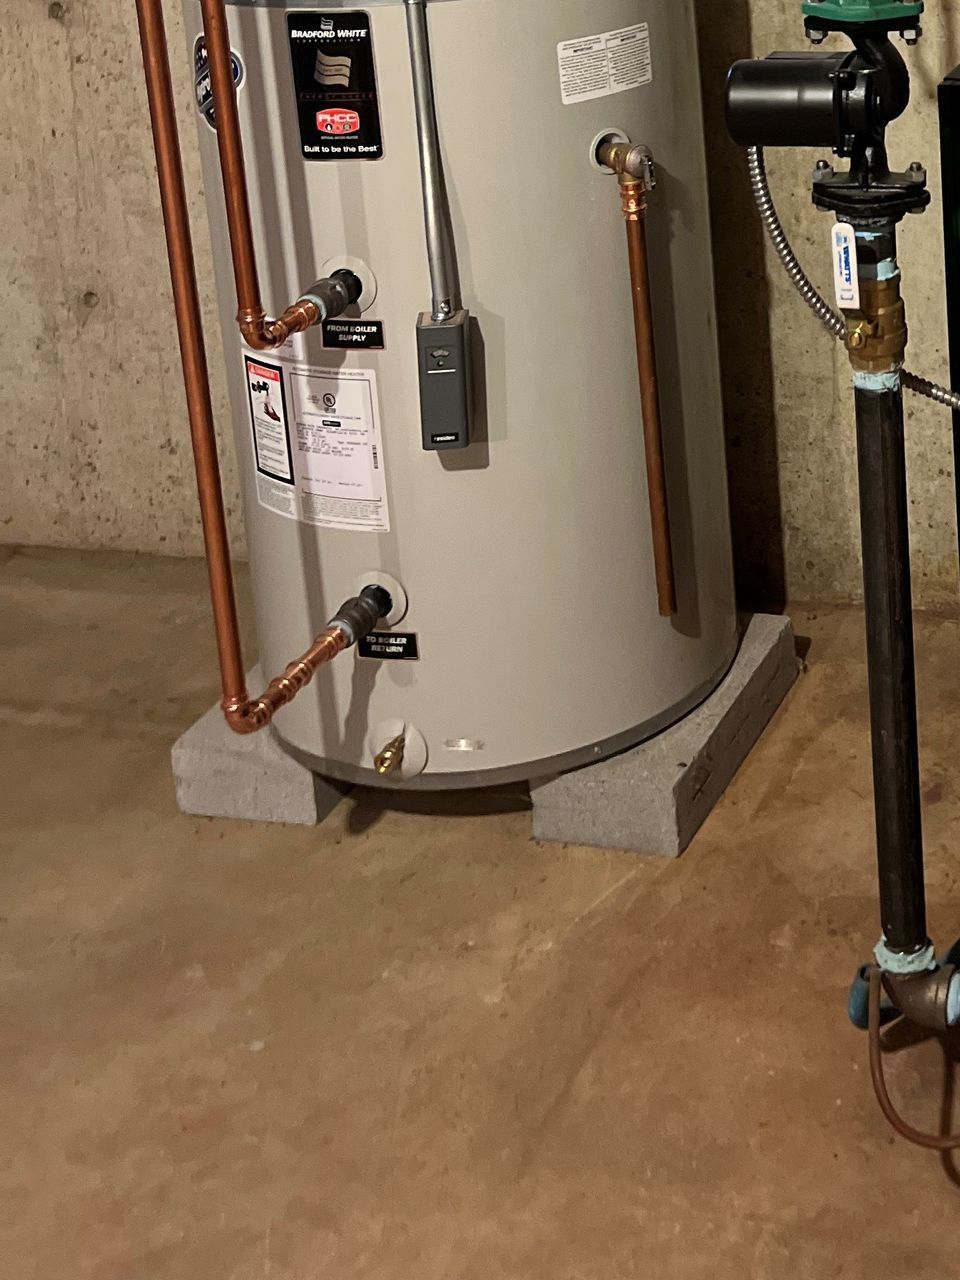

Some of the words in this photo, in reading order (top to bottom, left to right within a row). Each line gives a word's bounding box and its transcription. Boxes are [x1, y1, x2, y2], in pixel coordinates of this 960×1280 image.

[291, 29, 336, 38] BRADFORD
[337, 29, 367, 38] WHITE
[318, 113, 357, 123] PHCC
[304, 145, 321, 153] Built
[843, 245, 852, 285] WATTS
[327, 324, 349, 332] FROM
[350, 325, 377, 333] BOILER
[338, 334, 367, 342] SUPPLY
[371, 645, 403, 653] RETURN
